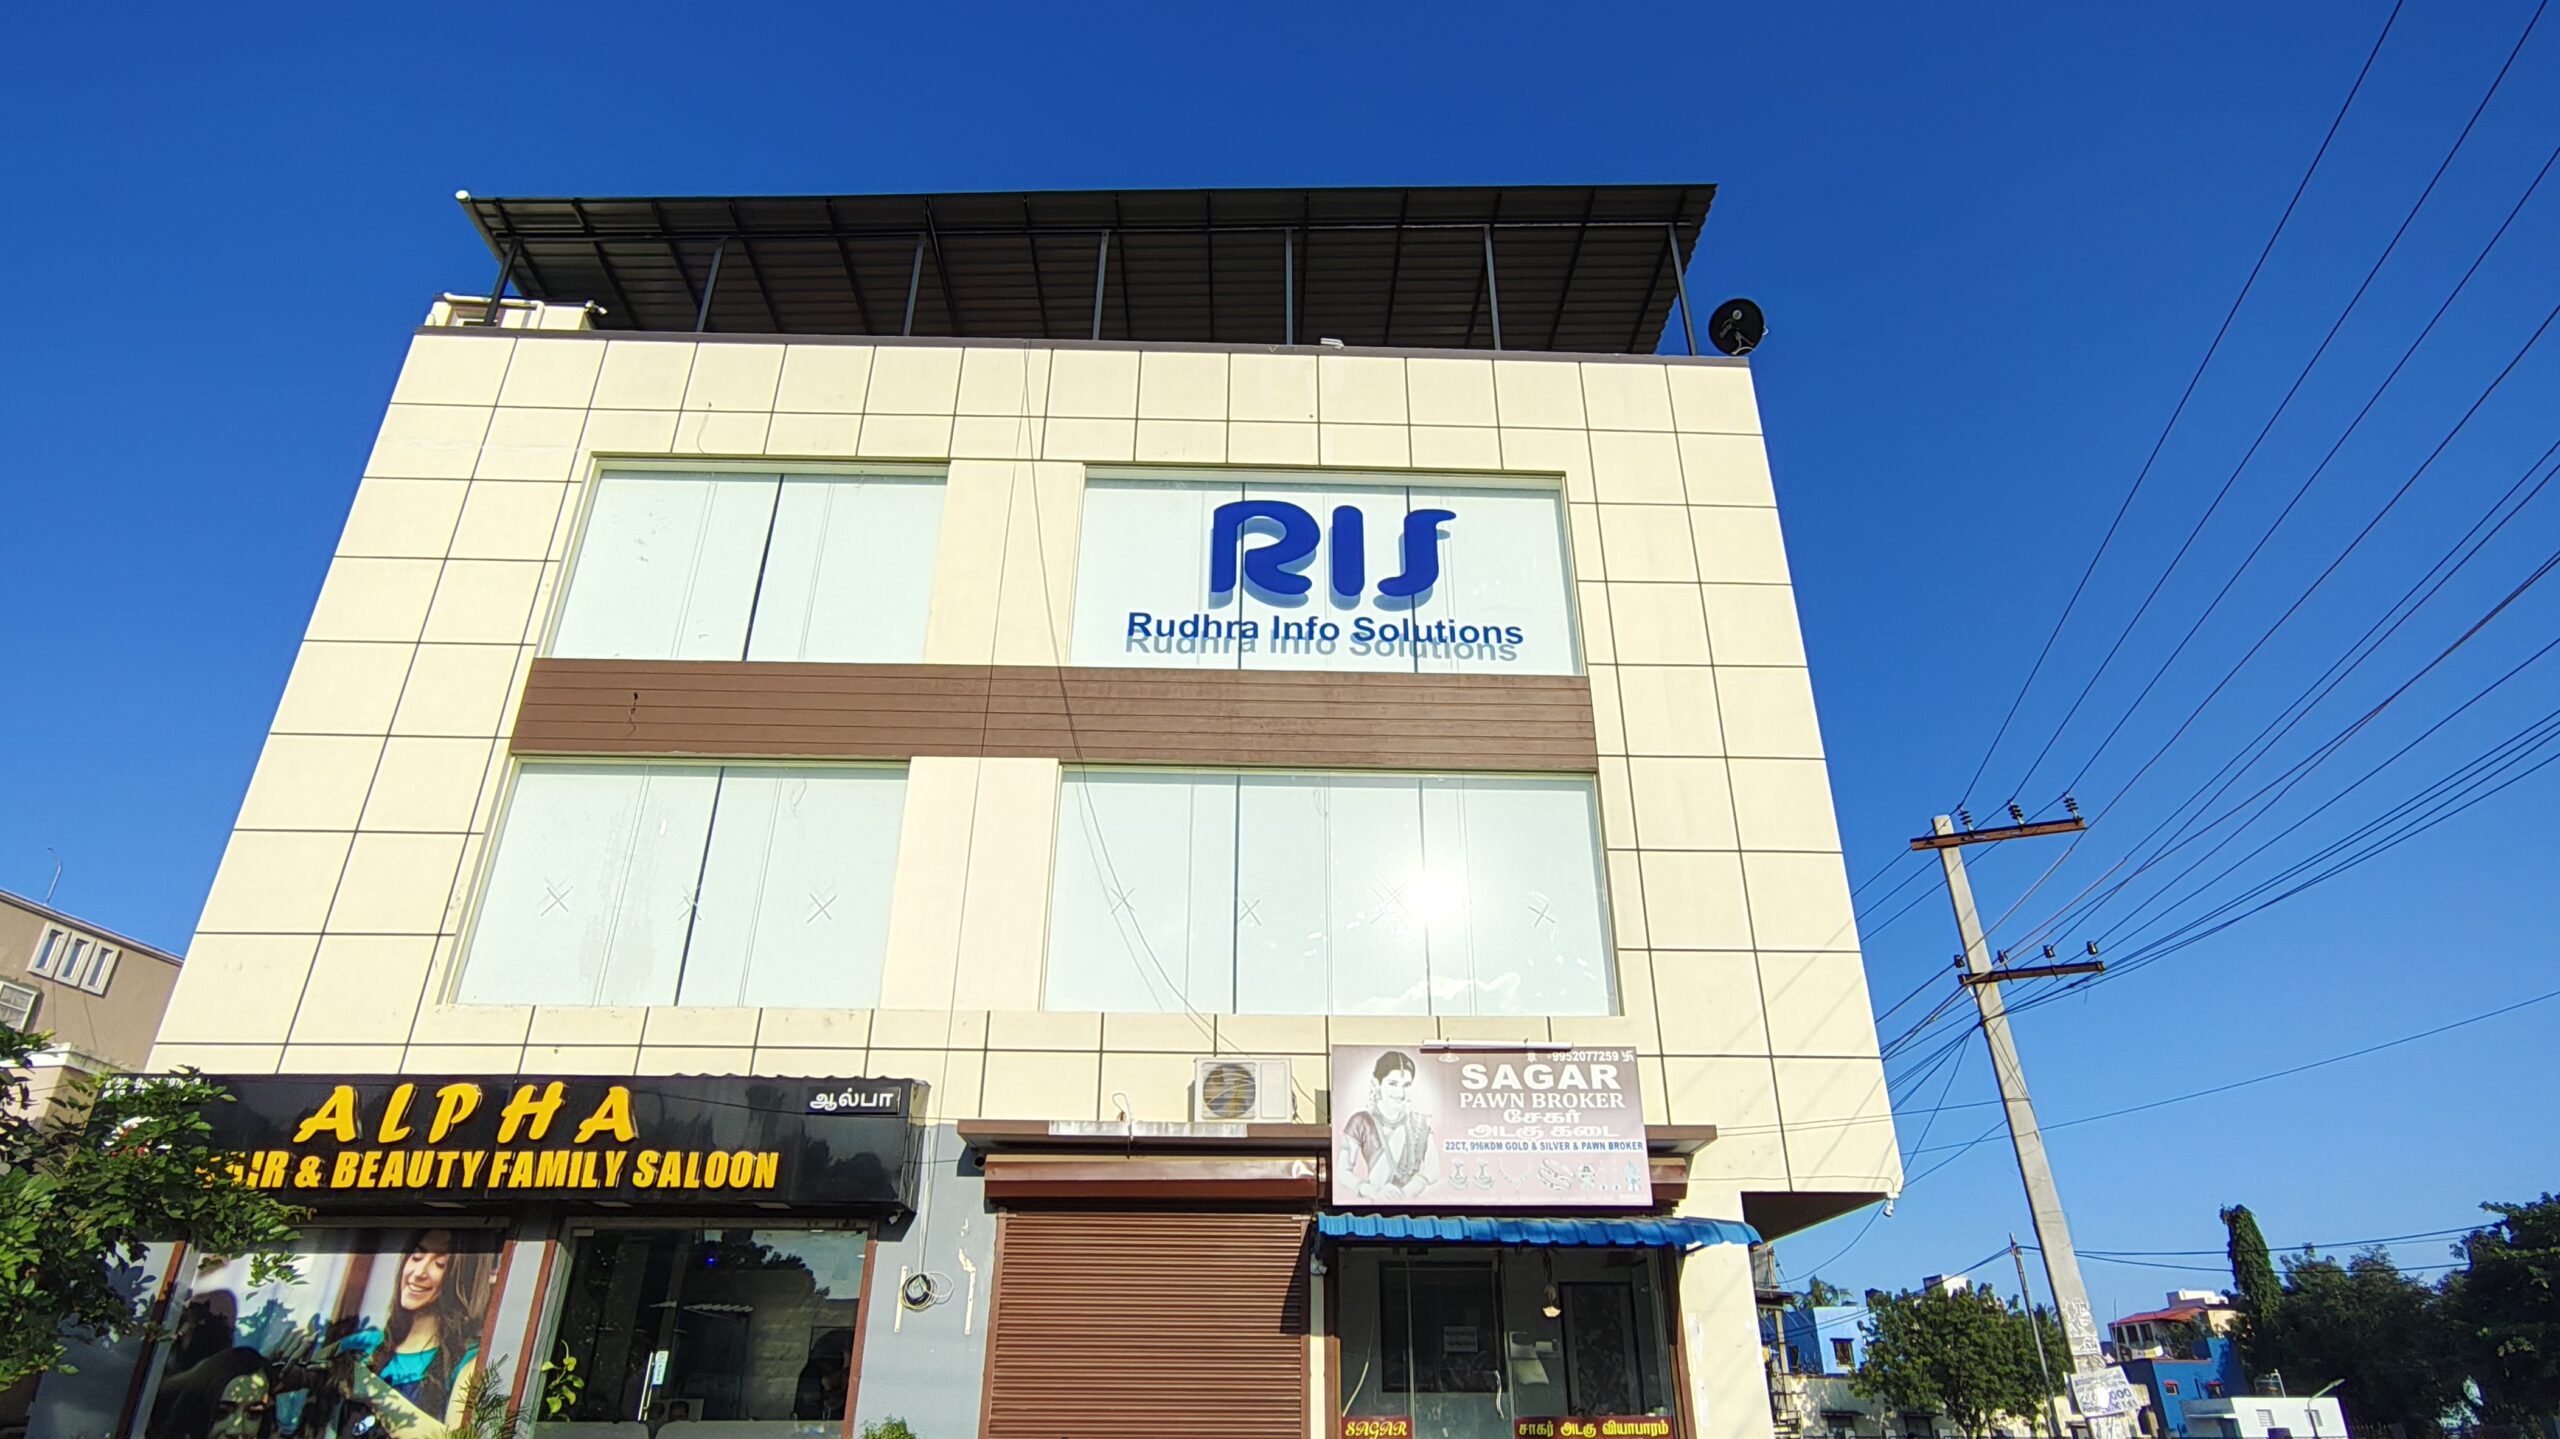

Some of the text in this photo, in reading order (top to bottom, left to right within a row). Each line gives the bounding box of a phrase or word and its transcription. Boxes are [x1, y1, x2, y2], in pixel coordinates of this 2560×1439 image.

[1211, 500, 1457, 597] RIS
[1127, 611, 1525, 645] Rudhra Info Solutions
[1461, 1063, 1621, 1090] SAGAR
[809, 1087, 895, 1111] ஆல்பா
[1460, 1092, 1625, 1109] PAWN BROKER
[293, 1081, 637, 1144] ALPHA
[1503, 1108, 1582, 1124] சேகர்
[1467, 1123, 1620, 1140] அடகு கடை
[1445, 1141, 1644, 1152] 22CT, 916KDM GOLD & SILVER & PAWN BROKER
[294, 1155, 323, 1189] &
[330, 1150, 486, 1189] BEAUTY
[487, 1150, 627, 1189] FAMILY
[632, 1150, 780, 1189] SALOON
[1345, 1420, 1408, 1439] SAGAR
[1519, 1419, 1669, 1438] சாகர் அடகு வியாபாரம்
